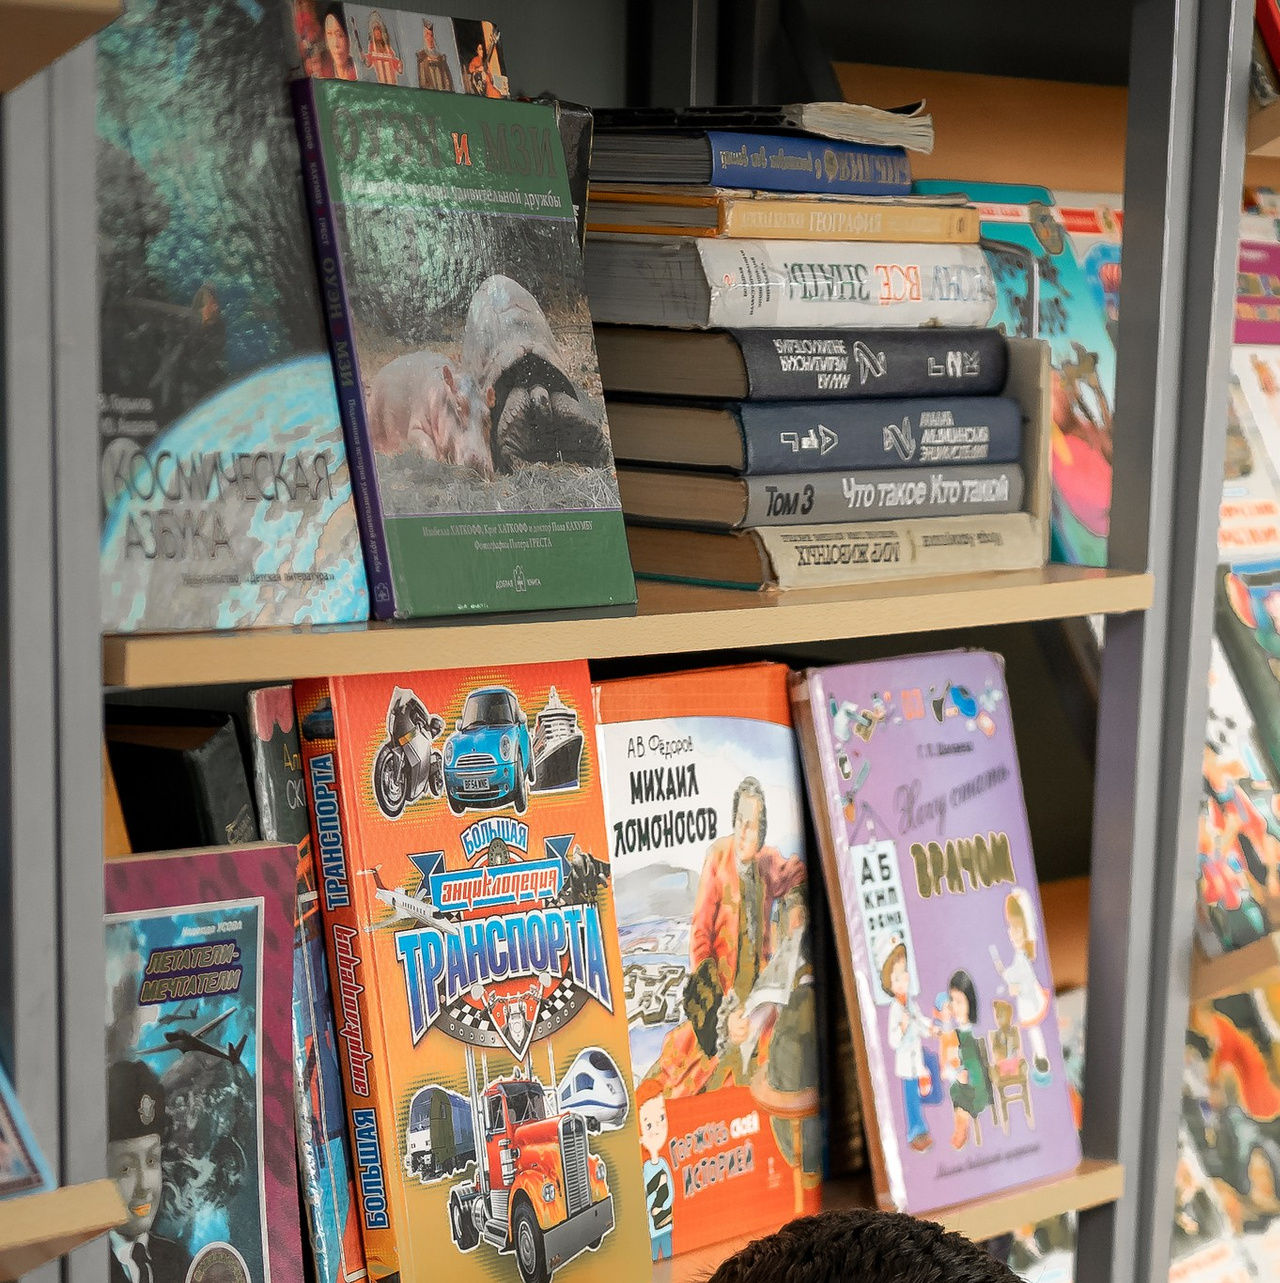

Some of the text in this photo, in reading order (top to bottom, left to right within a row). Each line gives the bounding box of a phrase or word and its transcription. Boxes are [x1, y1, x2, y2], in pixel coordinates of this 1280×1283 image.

[481, 121, 557, 177] МЗИ
[524, 189, 562, 212] дружбы
[809, 211, 883, 233] ГЕОГРАФИЯ
[783, 262, 870, 301] ЗНАТЬ!
[874, 264, 922, 306] ВСЁ
[323, 257, 343, 320] ОУЭН
[336, 341, 354, 388] МЗИ
[112, 450, 334, 501] КОСМИЧЕСКАЯ
[842, 473, 1009, 508] Что такое Кто такой
[765, 483, 815, 517] Том 3
[124, 508, 236, 560] АЗБУКА
[795, 542, 870, 567] ЖИВОТНЫХ
[629, 763, 700, 805] МИХАИЛ
[462, 816, 528, 857] БОЛЬШАЯ
[613, 807, 718, 858] ЛОМОНОСОВ
[861, 853, 892, 886] А Б
[909, 831, 1016, 899] ВРАЧОМ
[441, 865, 558, 910] энциклопедия
[147, 943, 240, 974] ЛЕТАТЕЛИ-
[396, 904, 611, 1043] ТРАНСПОРТА
[140, 969, 242, 1003] МЕЧТАТЕЛИ
[309, 753, 393, 1230] БОЛЬШАЯ энциклопедия ТРАНСПОРТА
[669, 1120, 729, 1171] ГОРЖУСЬ
[681, 1139, 755, 1200] ИСТОРИЕЙ
